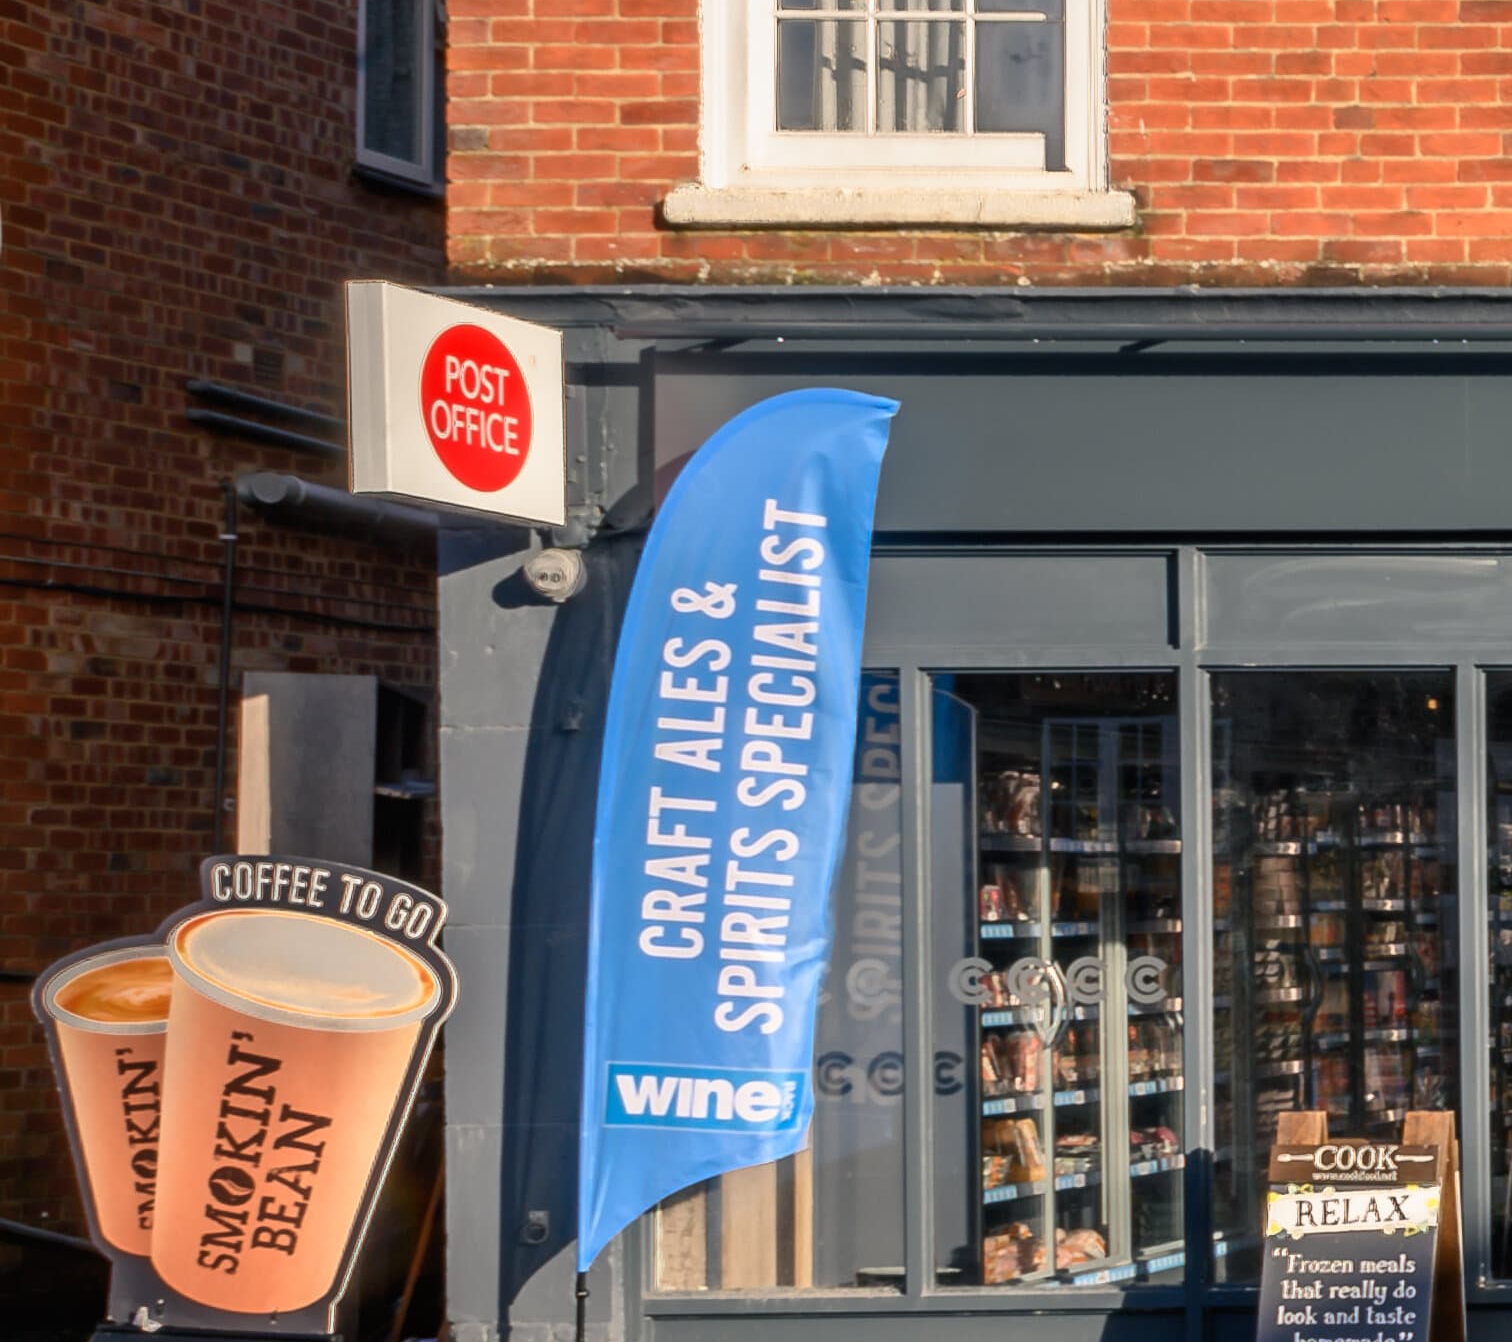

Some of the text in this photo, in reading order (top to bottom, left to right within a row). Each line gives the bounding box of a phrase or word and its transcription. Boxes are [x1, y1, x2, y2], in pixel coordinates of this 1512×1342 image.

[445, 355, 509, 406] POST
[431, 399, 520, 456] OFFICE
[638, 581, 737, 958] CRAFT ALES &
[715, 498, 827, 1036] SPIRITS SPECIALIST
[211, 861, 433, 939] COFFEE TO GO
[616, 1074, 782, 1123] wine
[197, 1030, 282, 1276] SMOKIN'
[1313, 1144, 1400, 1171] COOK
[251, 1103, 333, 1256] BEAN
[1295, 1195, 1411, 1227] RELAX
[1360, 1253, 1417, 1273] meals
[1276, 1305, 1417, 1326] look and taste
[1281, 1279, 1417, 1306] that really do
